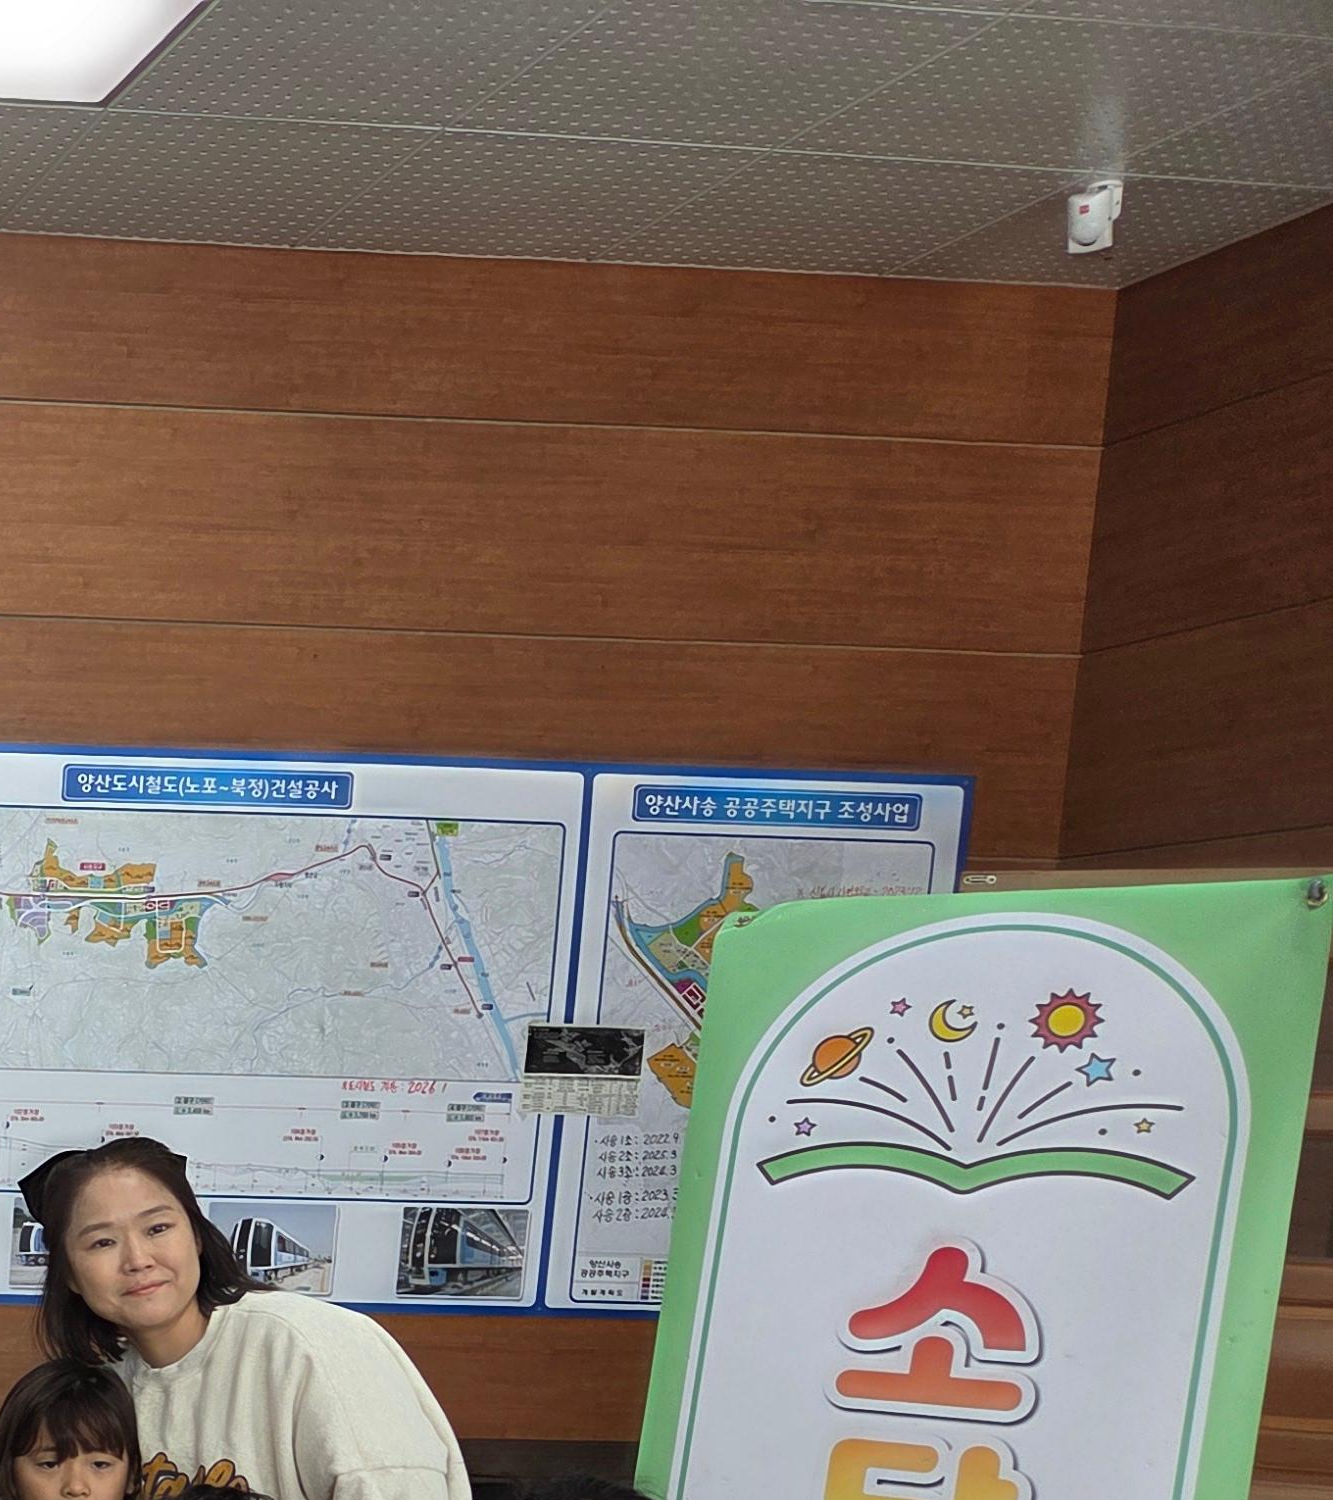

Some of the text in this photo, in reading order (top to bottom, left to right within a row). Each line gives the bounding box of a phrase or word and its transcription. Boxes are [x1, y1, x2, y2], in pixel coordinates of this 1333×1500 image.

[76, 770, 340, 803] 양산도시철도(노포~북정)건설공사
[644, 793, 910, 824] 양산사송 공공주택지구 조성사업
